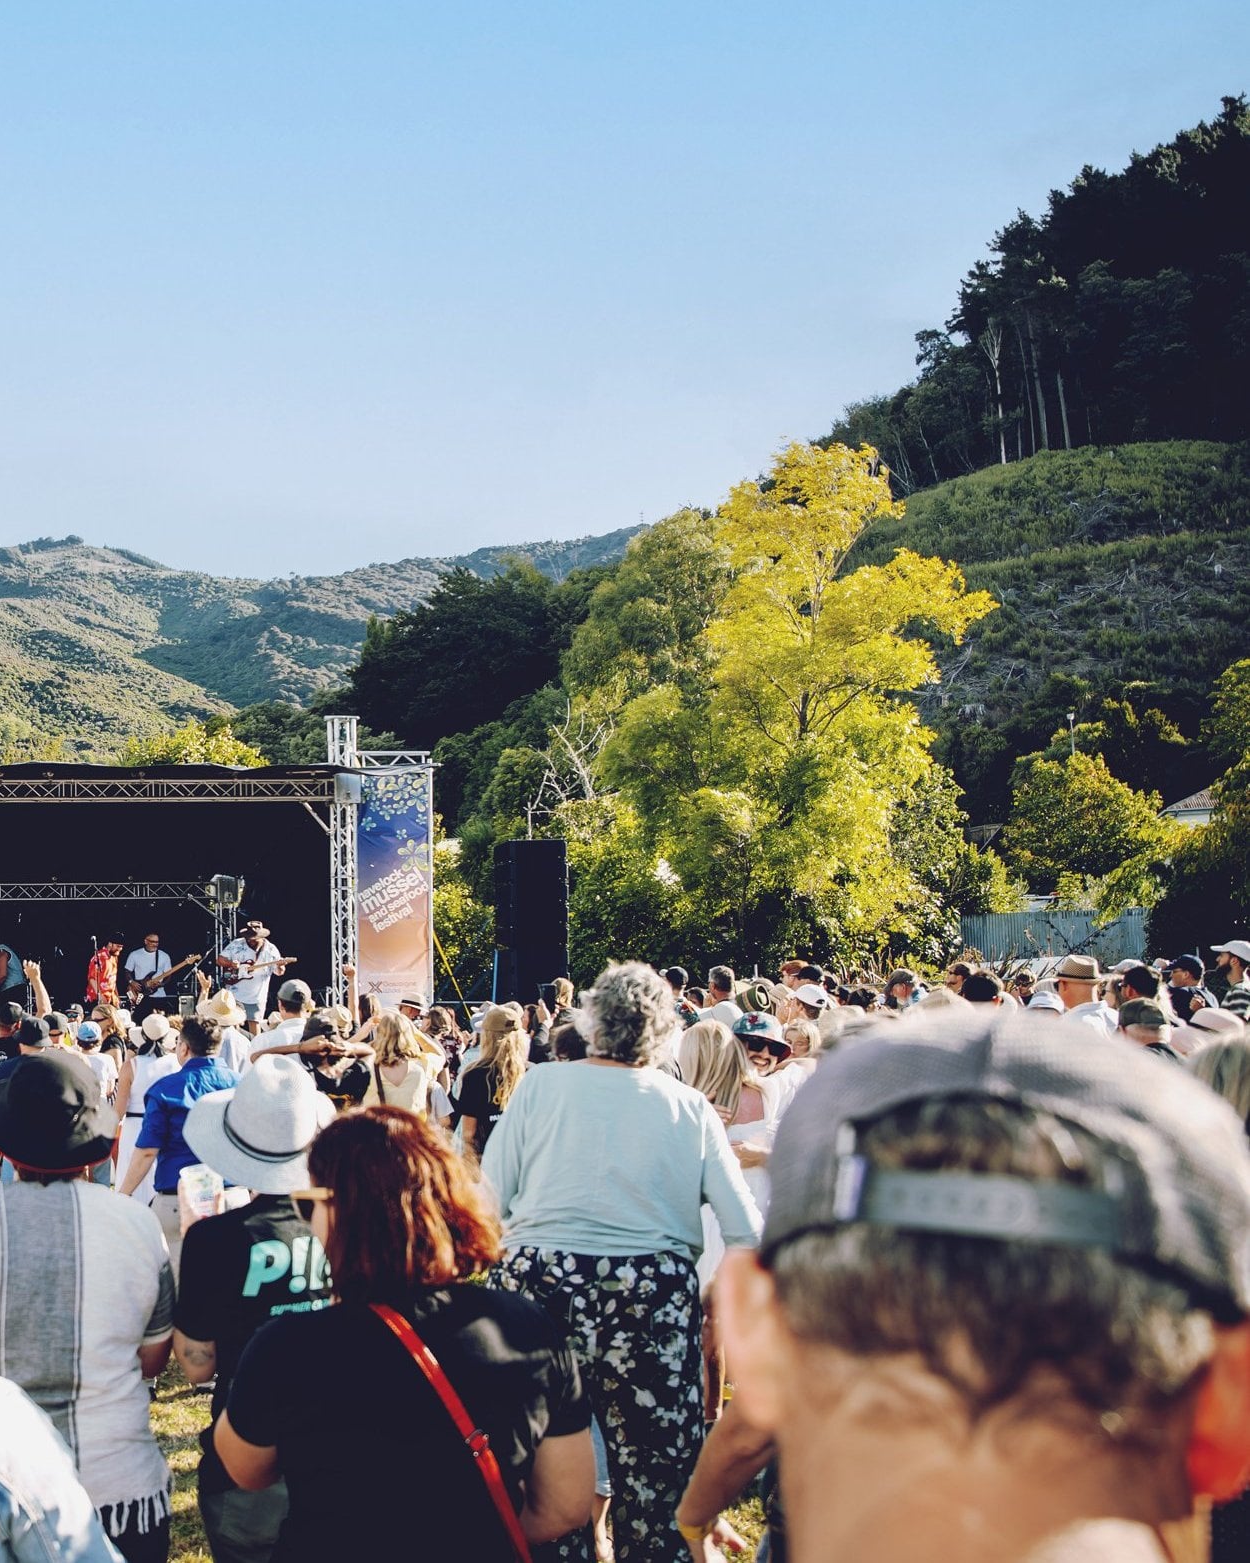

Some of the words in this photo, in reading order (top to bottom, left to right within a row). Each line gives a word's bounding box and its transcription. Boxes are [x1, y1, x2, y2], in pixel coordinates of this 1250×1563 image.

[361, 866, 425, 914] mussel
[369, 905, 389, 923] and
[387, 881, 429, 912] seafood
[372, 902, 414, 933] festival
